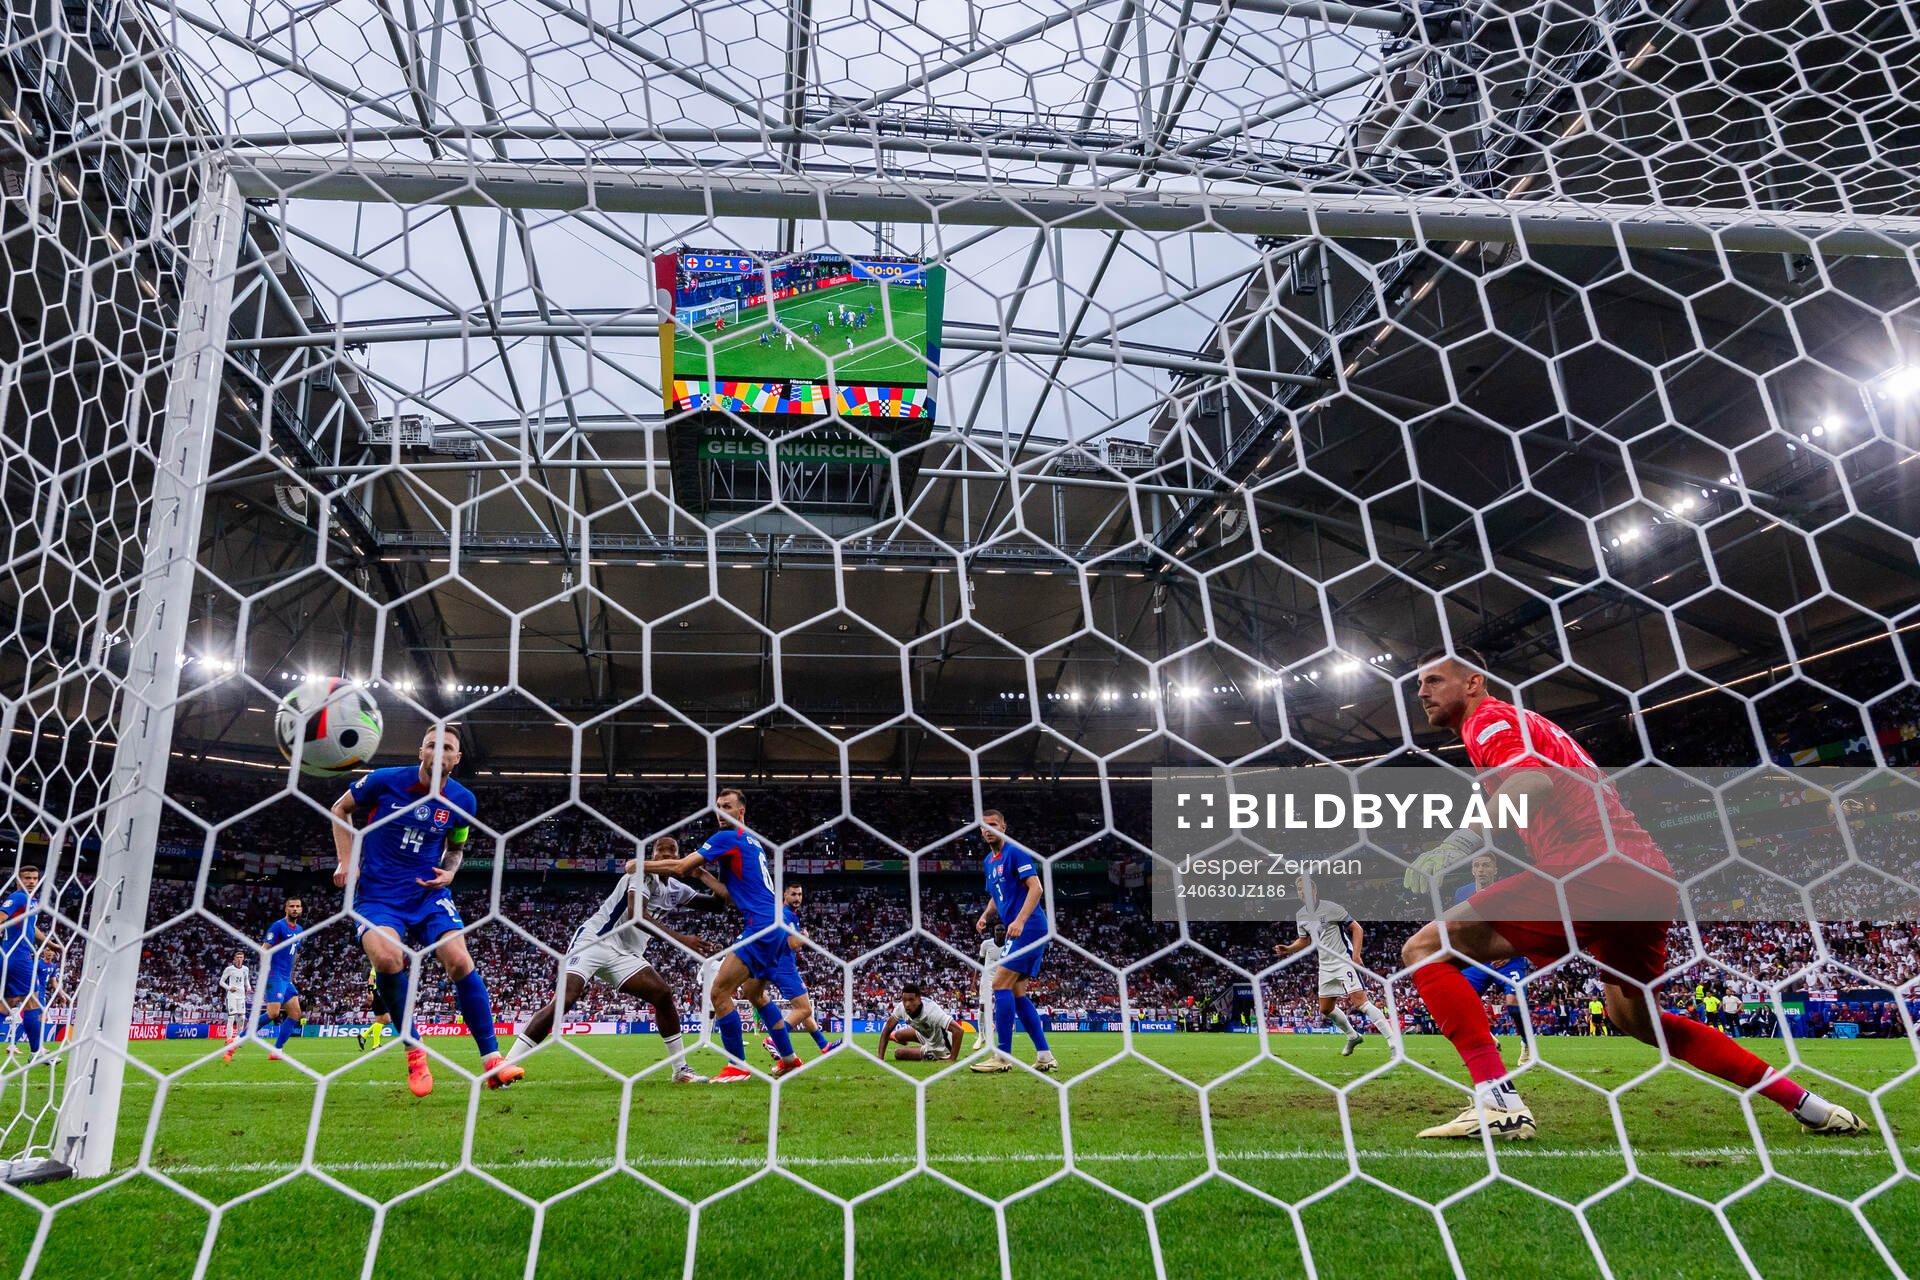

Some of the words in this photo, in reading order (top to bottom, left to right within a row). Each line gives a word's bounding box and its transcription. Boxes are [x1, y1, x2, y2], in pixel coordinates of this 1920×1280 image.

[707, 441, 890, 460] GELSNKIRCHEN
[1660, 804, 1740, 829] GELSENKIRCEN
[400, 826, 425, 853] 14
[1346, 971, 1354, 982] 9
[129, 1025, 159, 1040] TRAUSS
[318, 1024, 393, 1038] Hisee
[1051, 1022, 1078, 1031] WELCOME
[1079, 1022, 1090, 1031] ALL
[1141, 1023, 1172, 1031] RECYCLE
